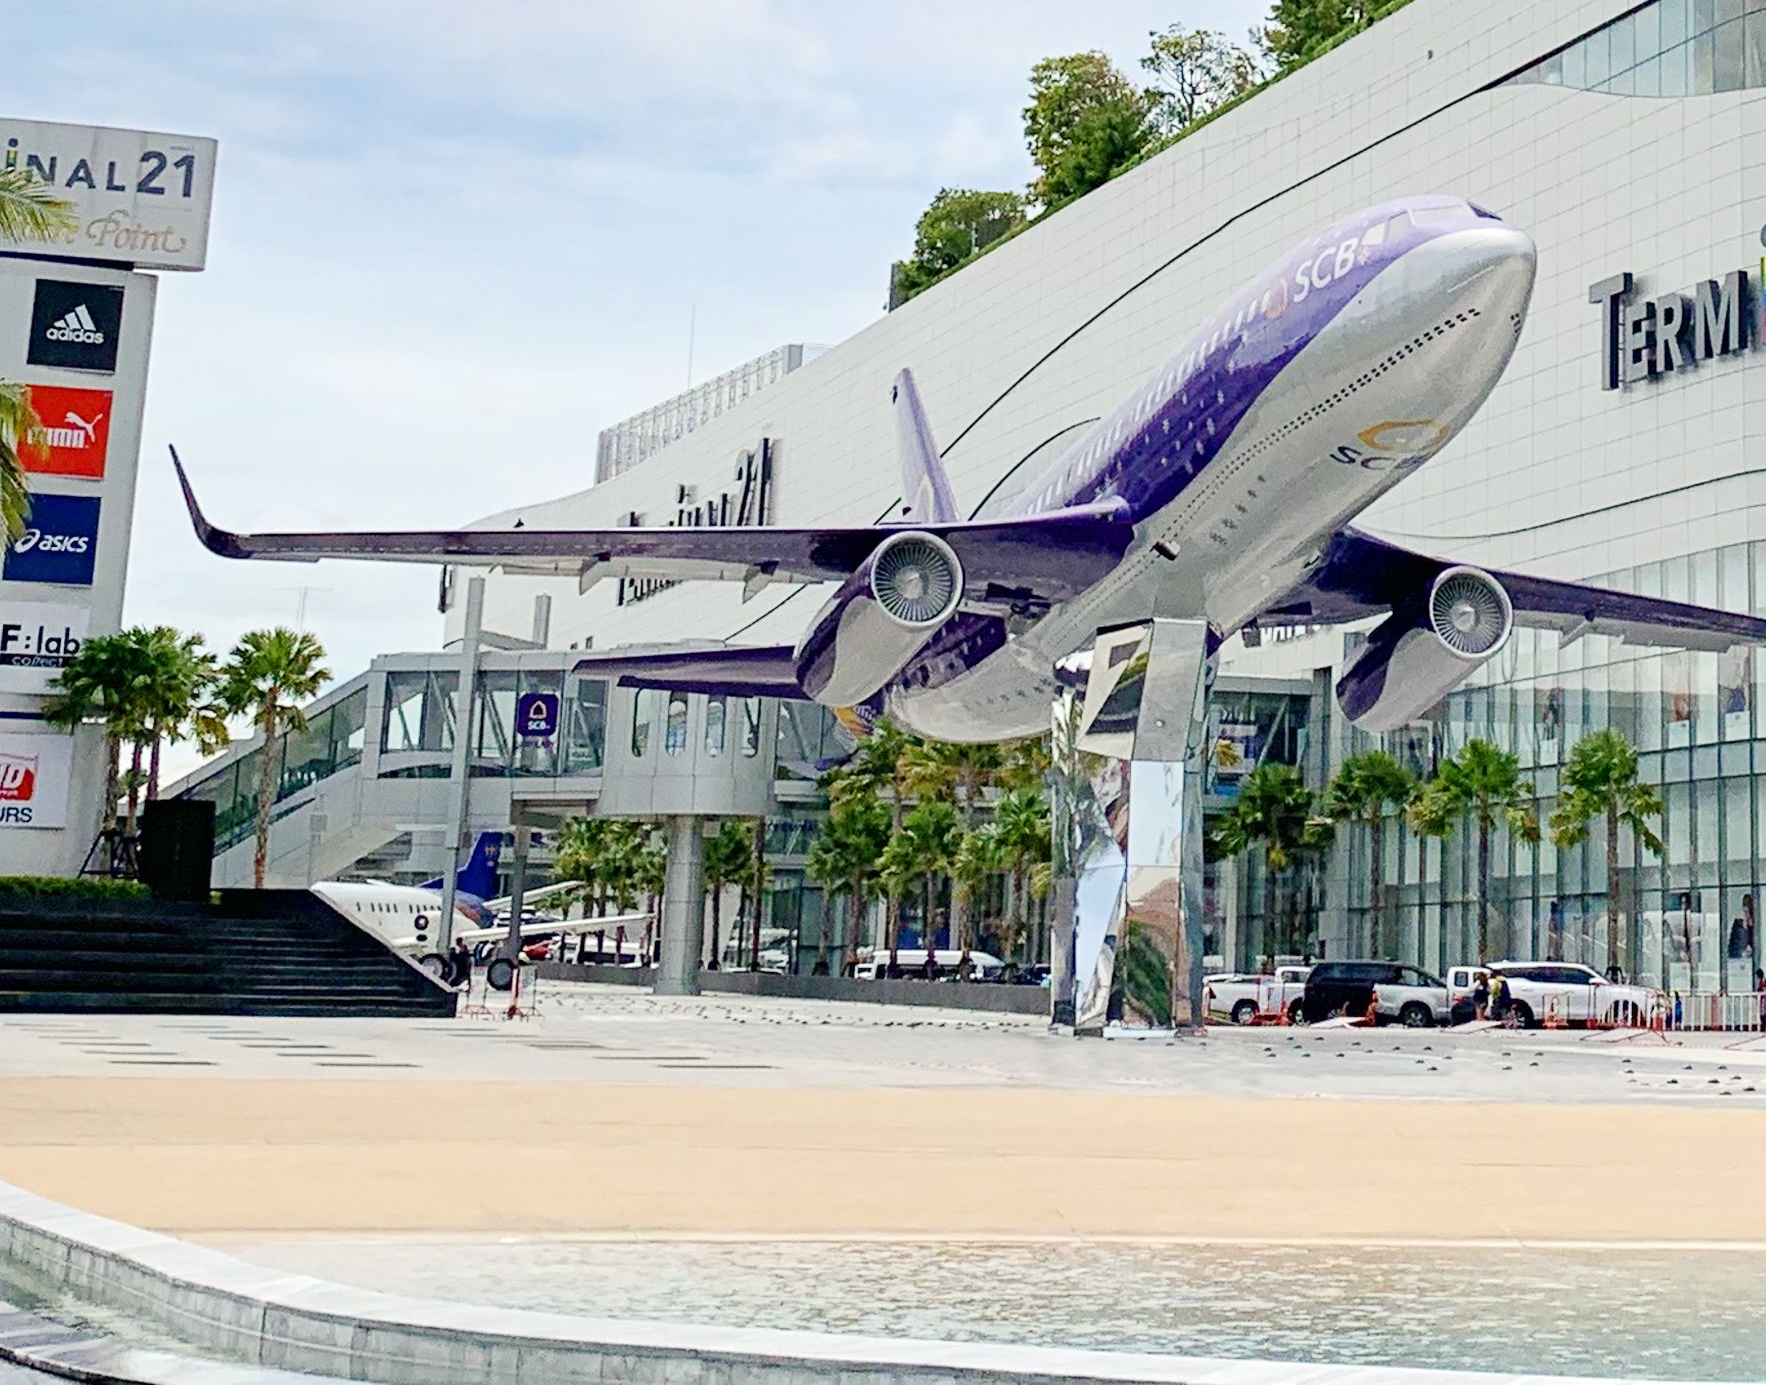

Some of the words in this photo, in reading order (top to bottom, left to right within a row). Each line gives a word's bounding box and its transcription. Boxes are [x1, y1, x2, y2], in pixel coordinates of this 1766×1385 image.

[136, 150, 195, 198] 21
[86, 209, 186, 253] Point
[1293, 237, 1359, 302] SCB
[46, 326, 104, 344] adidas
[38, 535, 89, 553] asics
